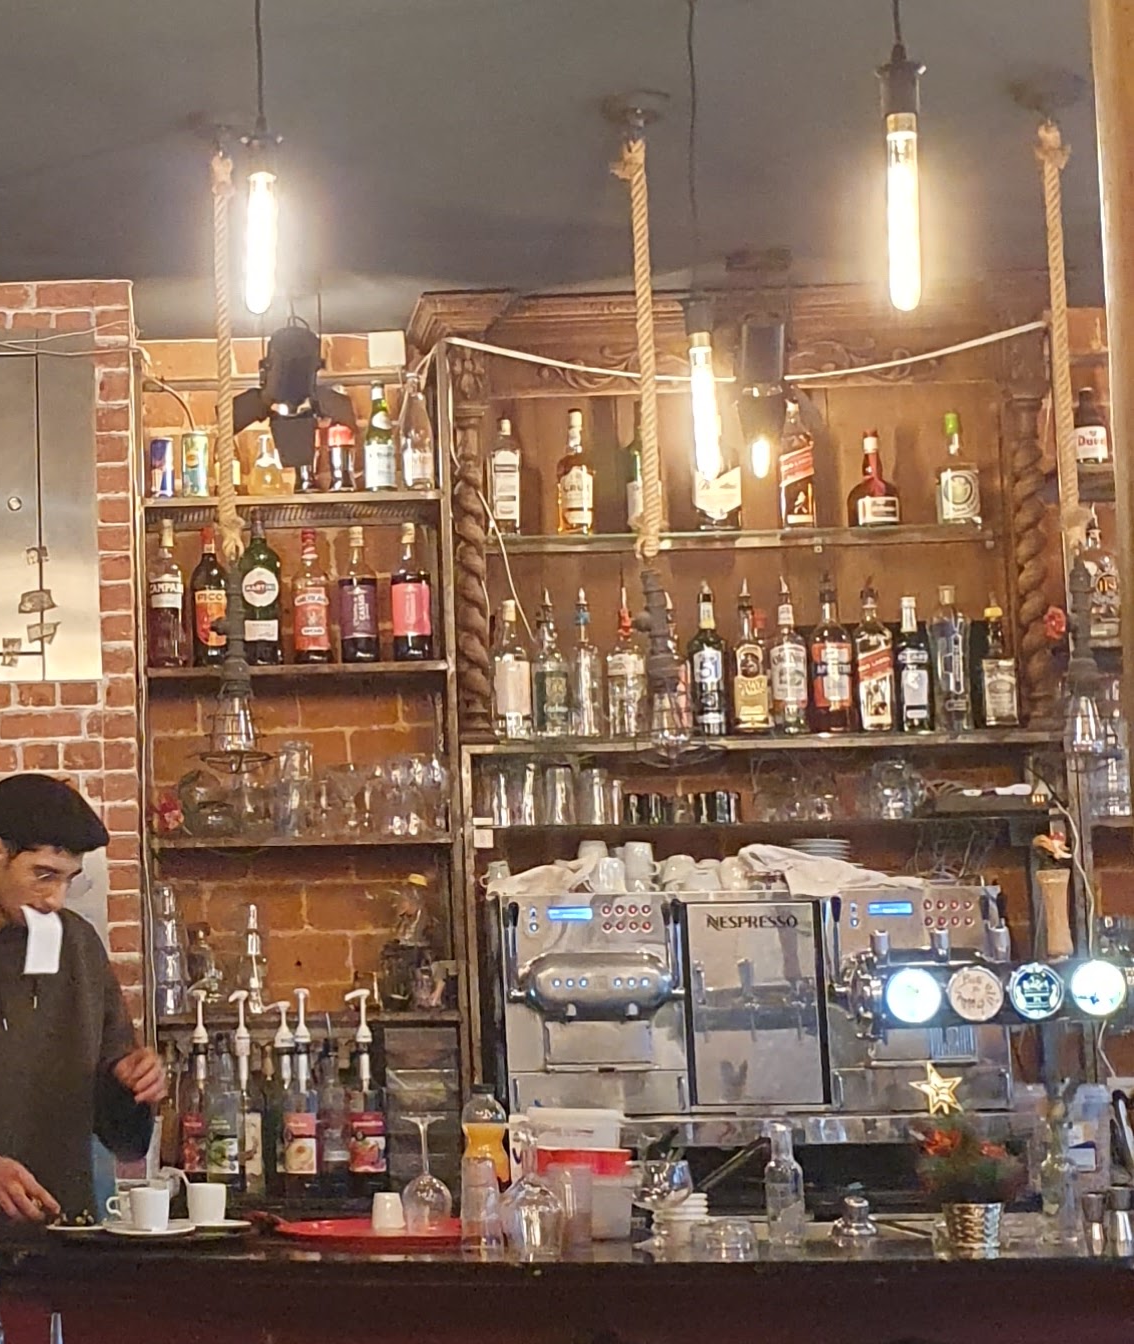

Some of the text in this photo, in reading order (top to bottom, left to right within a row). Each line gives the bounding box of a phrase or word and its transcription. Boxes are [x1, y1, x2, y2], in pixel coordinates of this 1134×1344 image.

[150, 582, 184, 594] CAMPA
[197, 592, 224, 601] PICO
[706, 913, 798, 931] NESPRESSO
